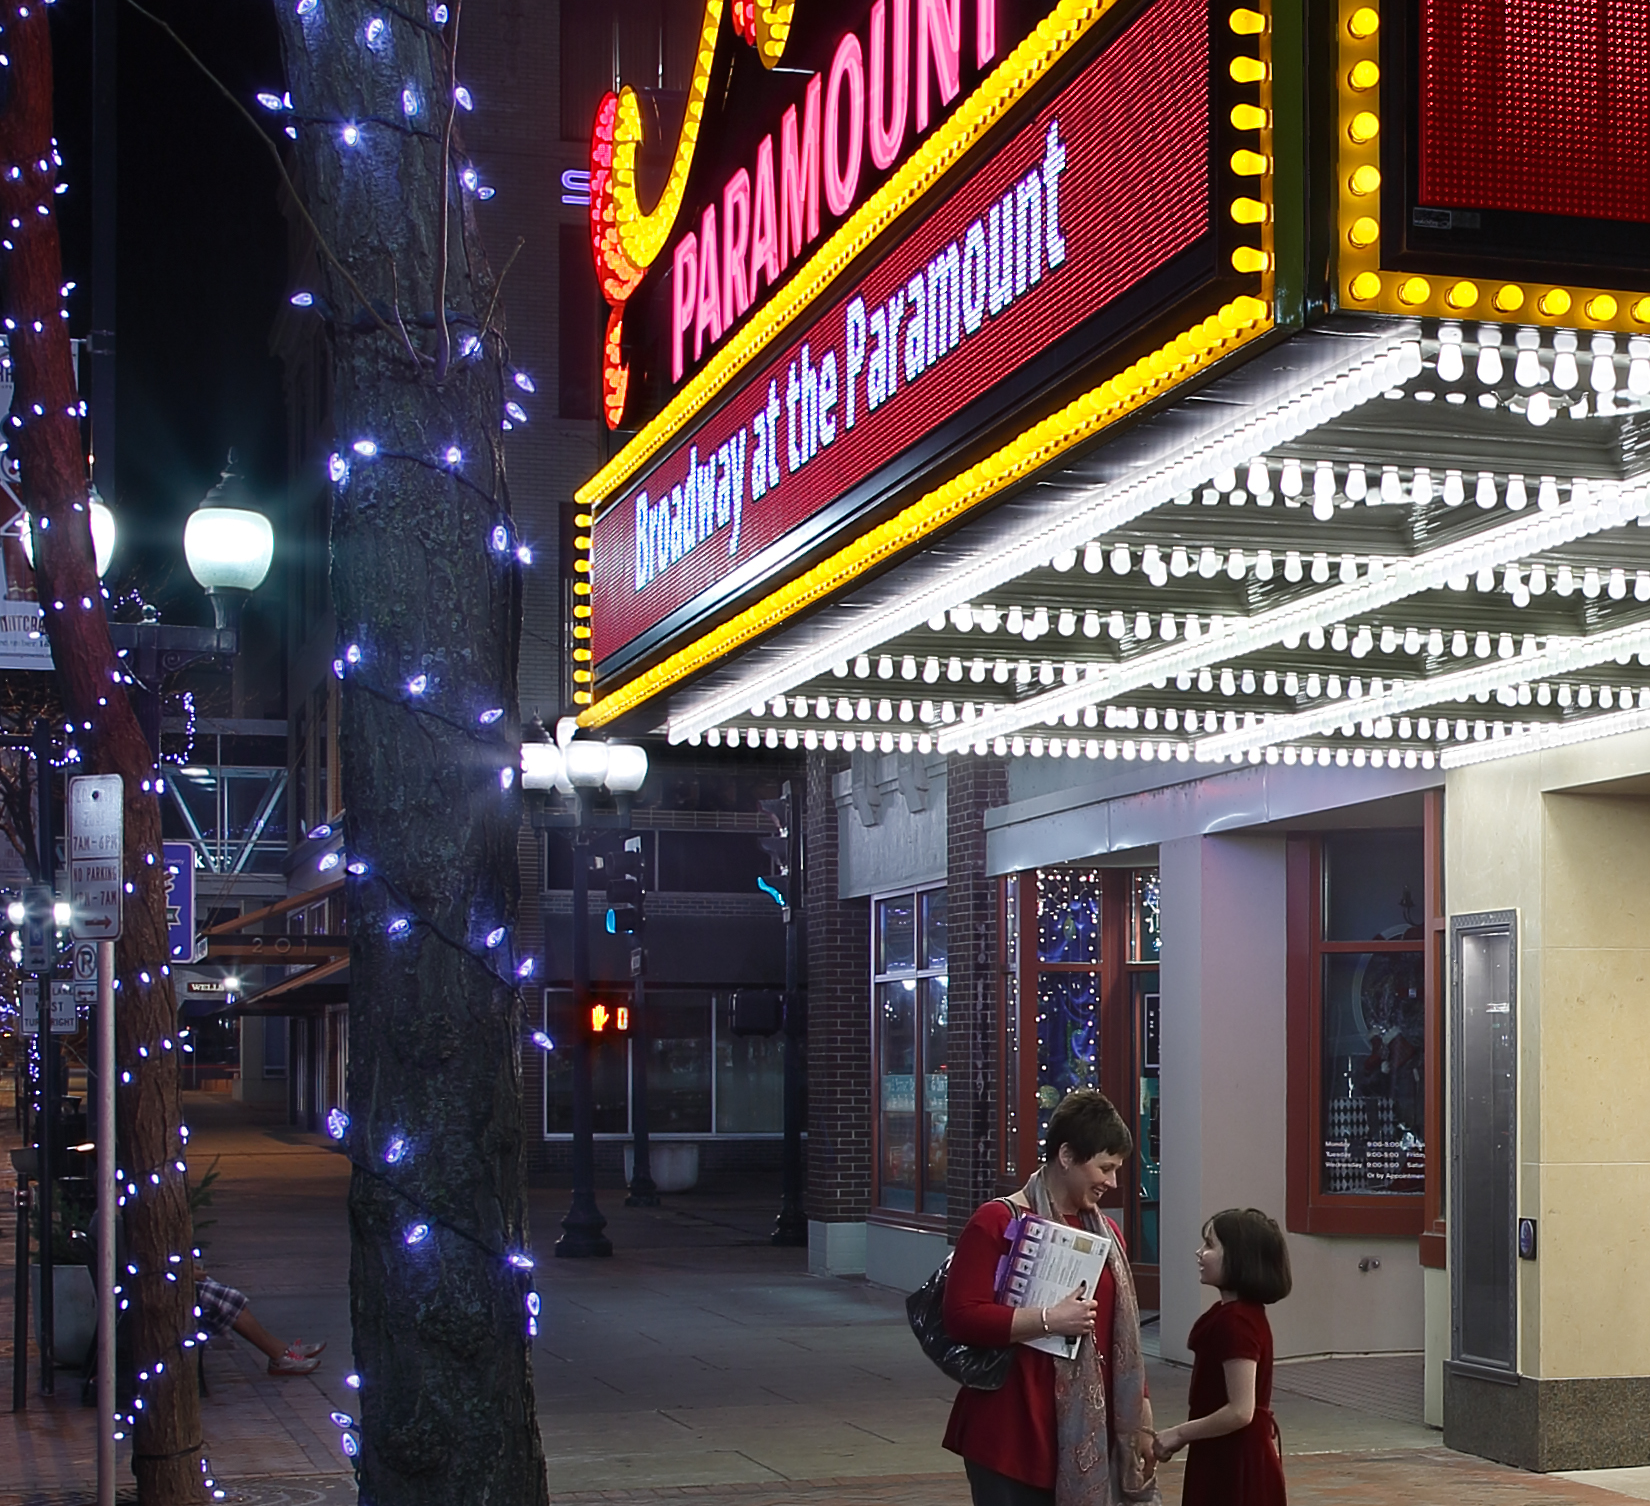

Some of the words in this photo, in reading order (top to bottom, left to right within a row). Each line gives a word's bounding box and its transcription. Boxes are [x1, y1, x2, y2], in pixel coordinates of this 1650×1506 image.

[633, 429, 746, 592] Broadway
[751, 378, 783, 503] at
[785, 343, 838, 471] the
[844, 116, 1068, 429] Paramount
[74, 867, 83, 882] NO
[86, 866, 117, 882] PARKING
[252, 937, 308, 953] 201
[191, 983, 224, 991] WELLS
[51, 1018, 75, 1026] RIGHT
